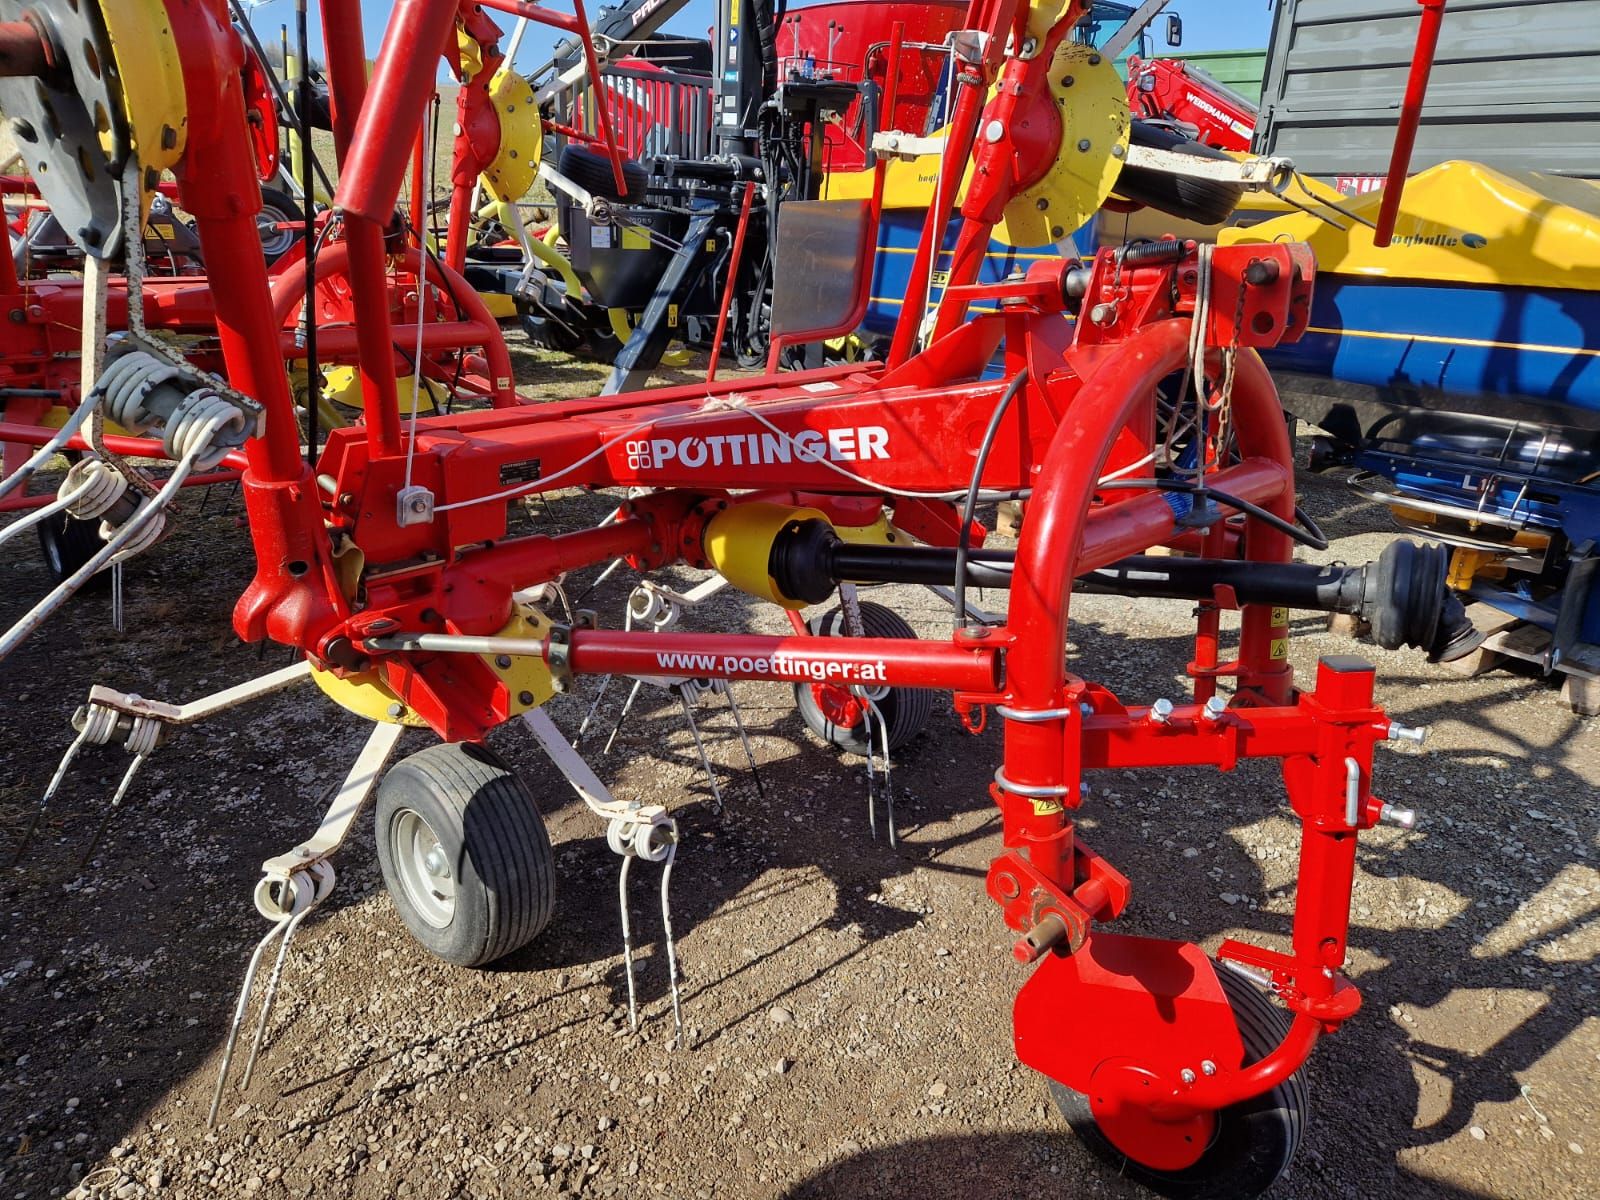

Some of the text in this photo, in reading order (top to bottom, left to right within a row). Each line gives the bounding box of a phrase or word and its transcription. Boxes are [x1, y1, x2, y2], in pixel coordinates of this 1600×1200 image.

[1186, 91, 1234, 127] WEIDEMANN
[1392, 233, 1458, 247] ogballe
[651, 426, 890, 469] PÖTTINGER
[656, 652, 887, 680] www.poettinger.at
